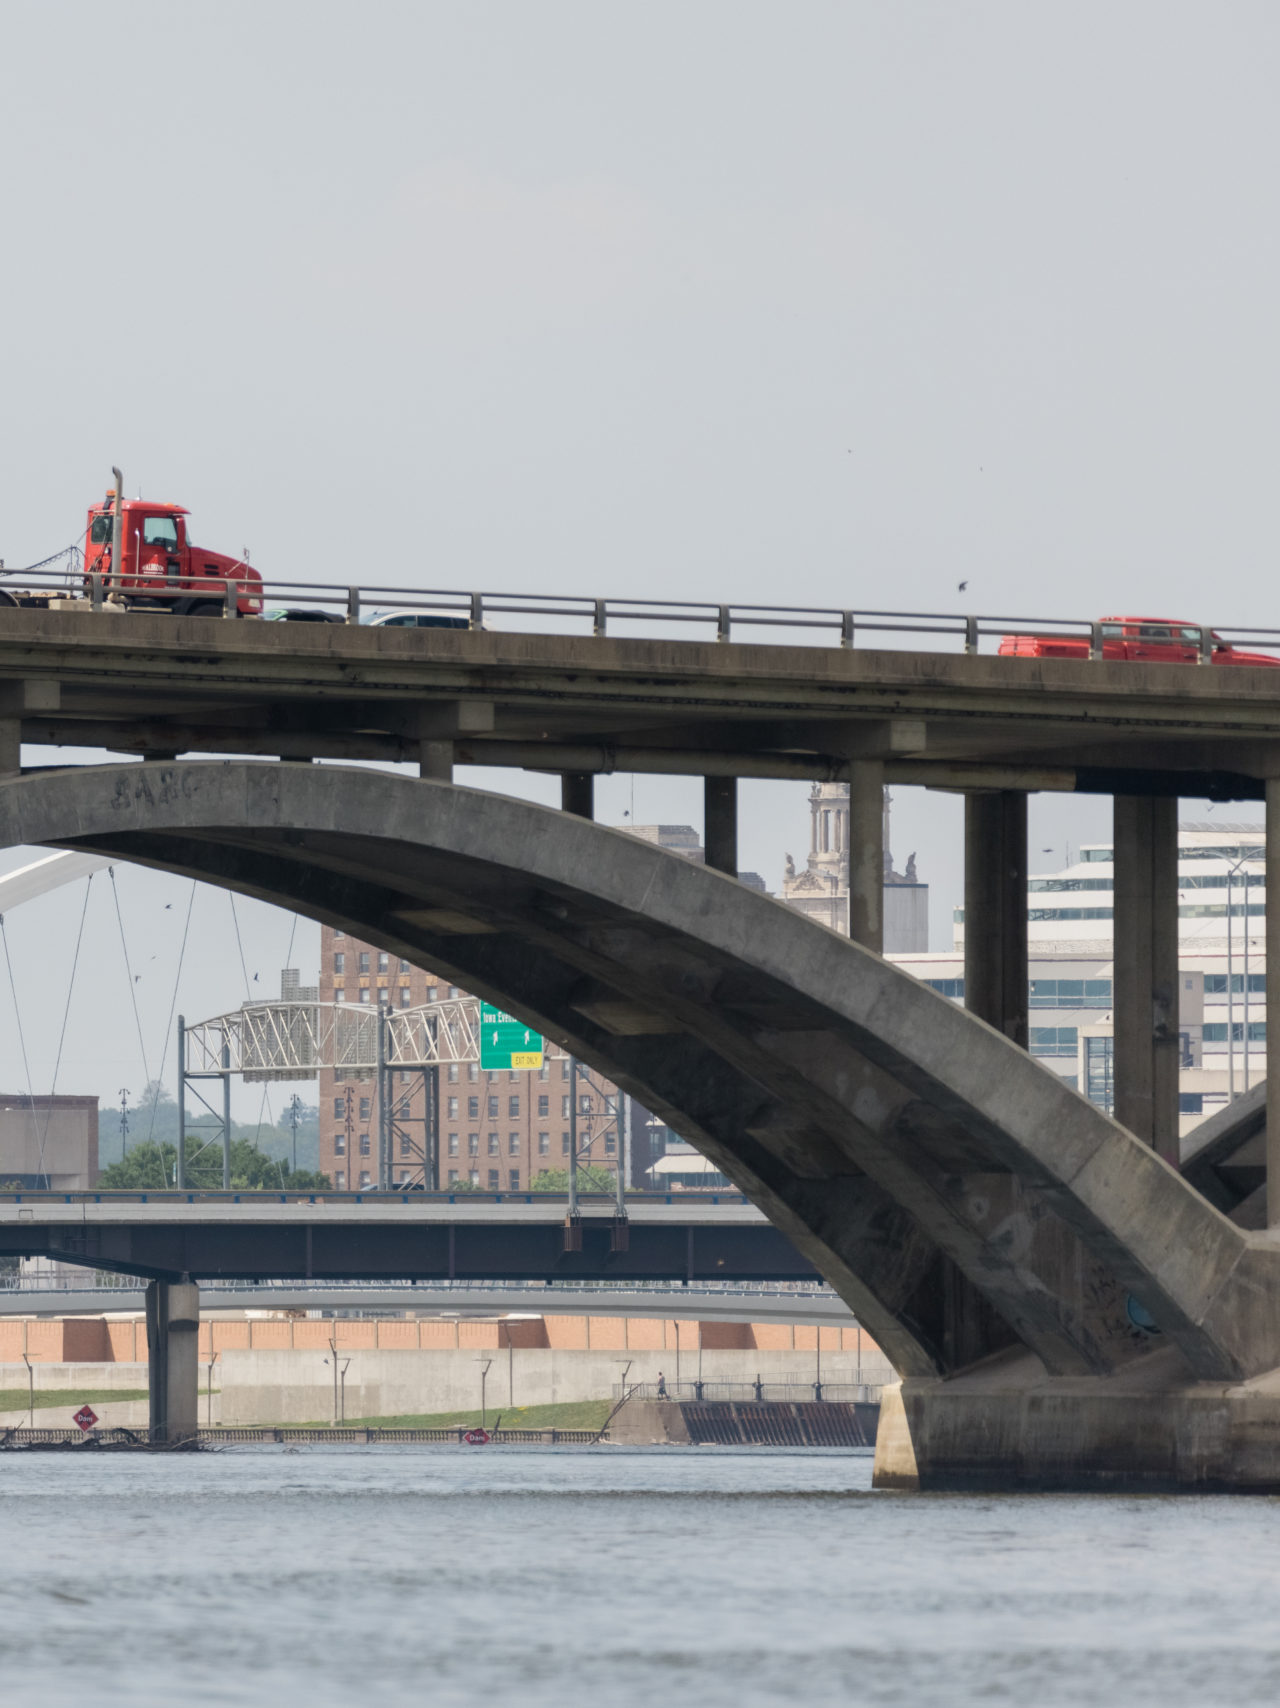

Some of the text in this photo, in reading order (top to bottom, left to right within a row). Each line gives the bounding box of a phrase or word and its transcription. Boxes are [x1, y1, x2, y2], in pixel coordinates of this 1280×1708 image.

[483, 1012, 496, 1023] Iowa
[515, 1056, 525, 1064] EXIT
[78, 1414, 93, 1422] Dam
